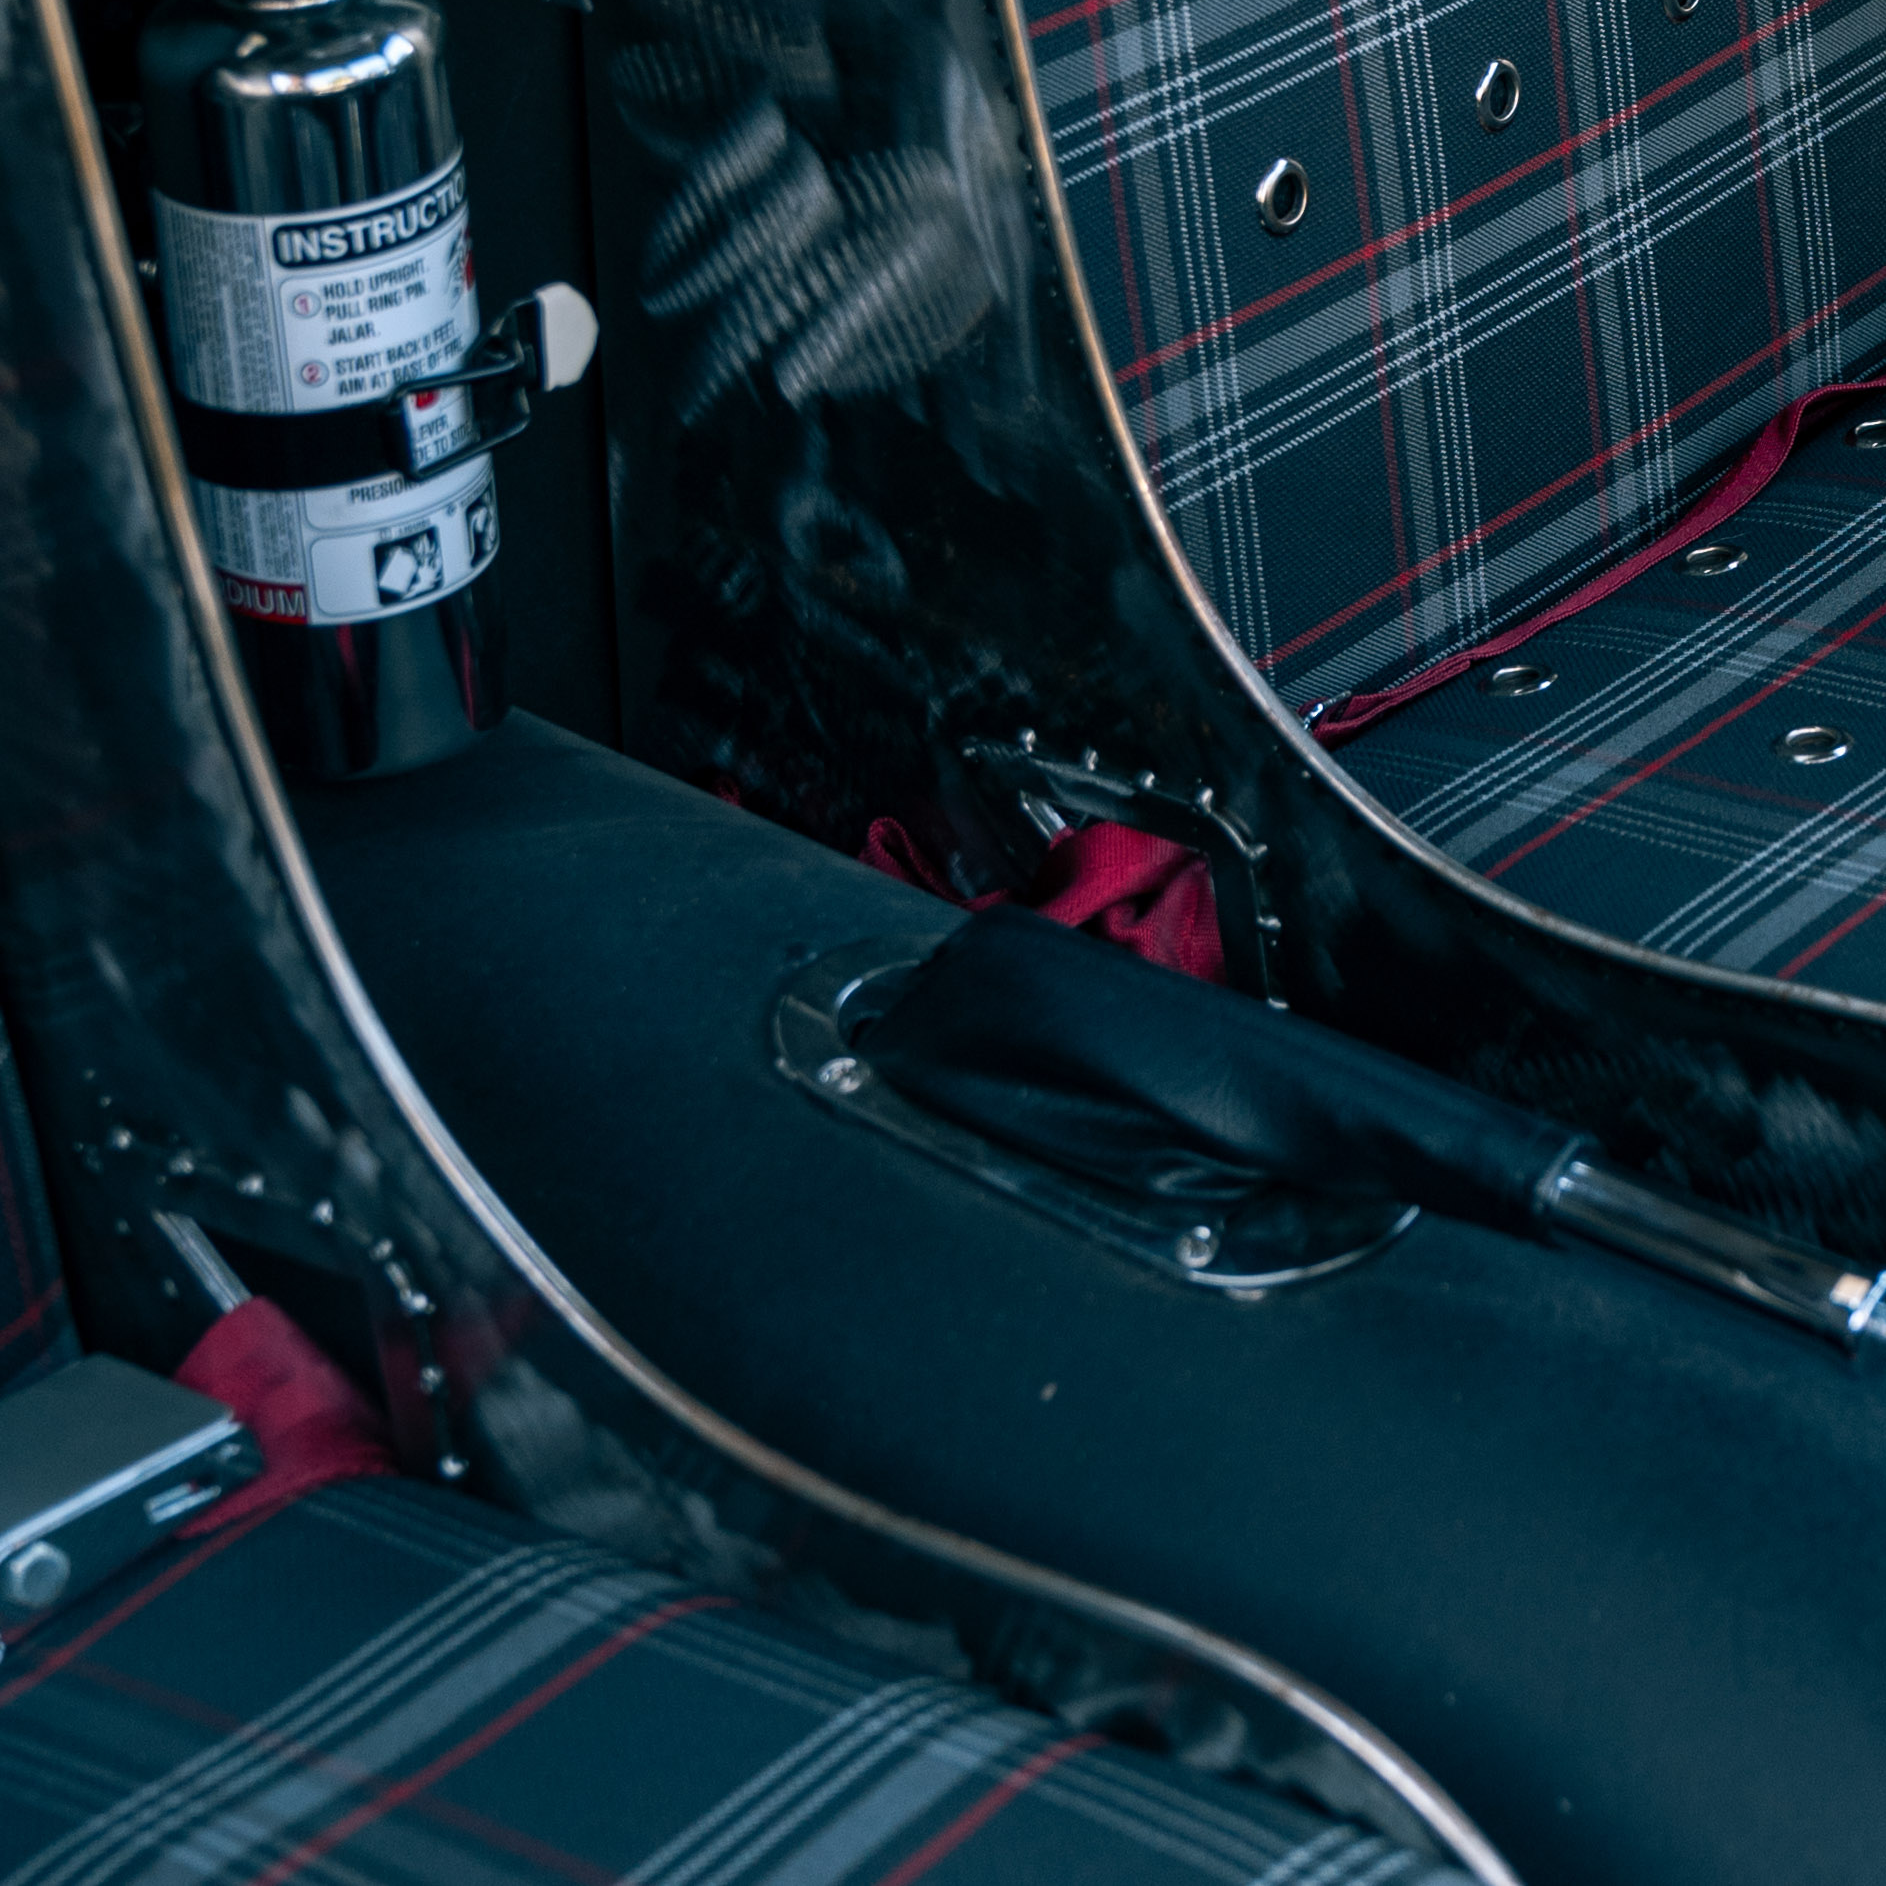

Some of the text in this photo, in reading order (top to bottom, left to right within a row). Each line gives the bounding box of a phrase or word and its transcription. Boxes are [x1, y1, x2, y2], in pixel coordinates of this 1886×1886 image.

[323, 279, 364, 301] HOLD
[326, 301, 361, 321] PULL
[367, 291, 402, 313] RING
[335, 352, 382, 375] START
[387, 339, 421, 364] BACK
[339, 377, 366, 397] AIM
[371, 370, 388, 390] AT
[393, 357, 425, 383] BASE
[428, 350, 441, 370] OF
[222, 577, 306, 617] DIUM
